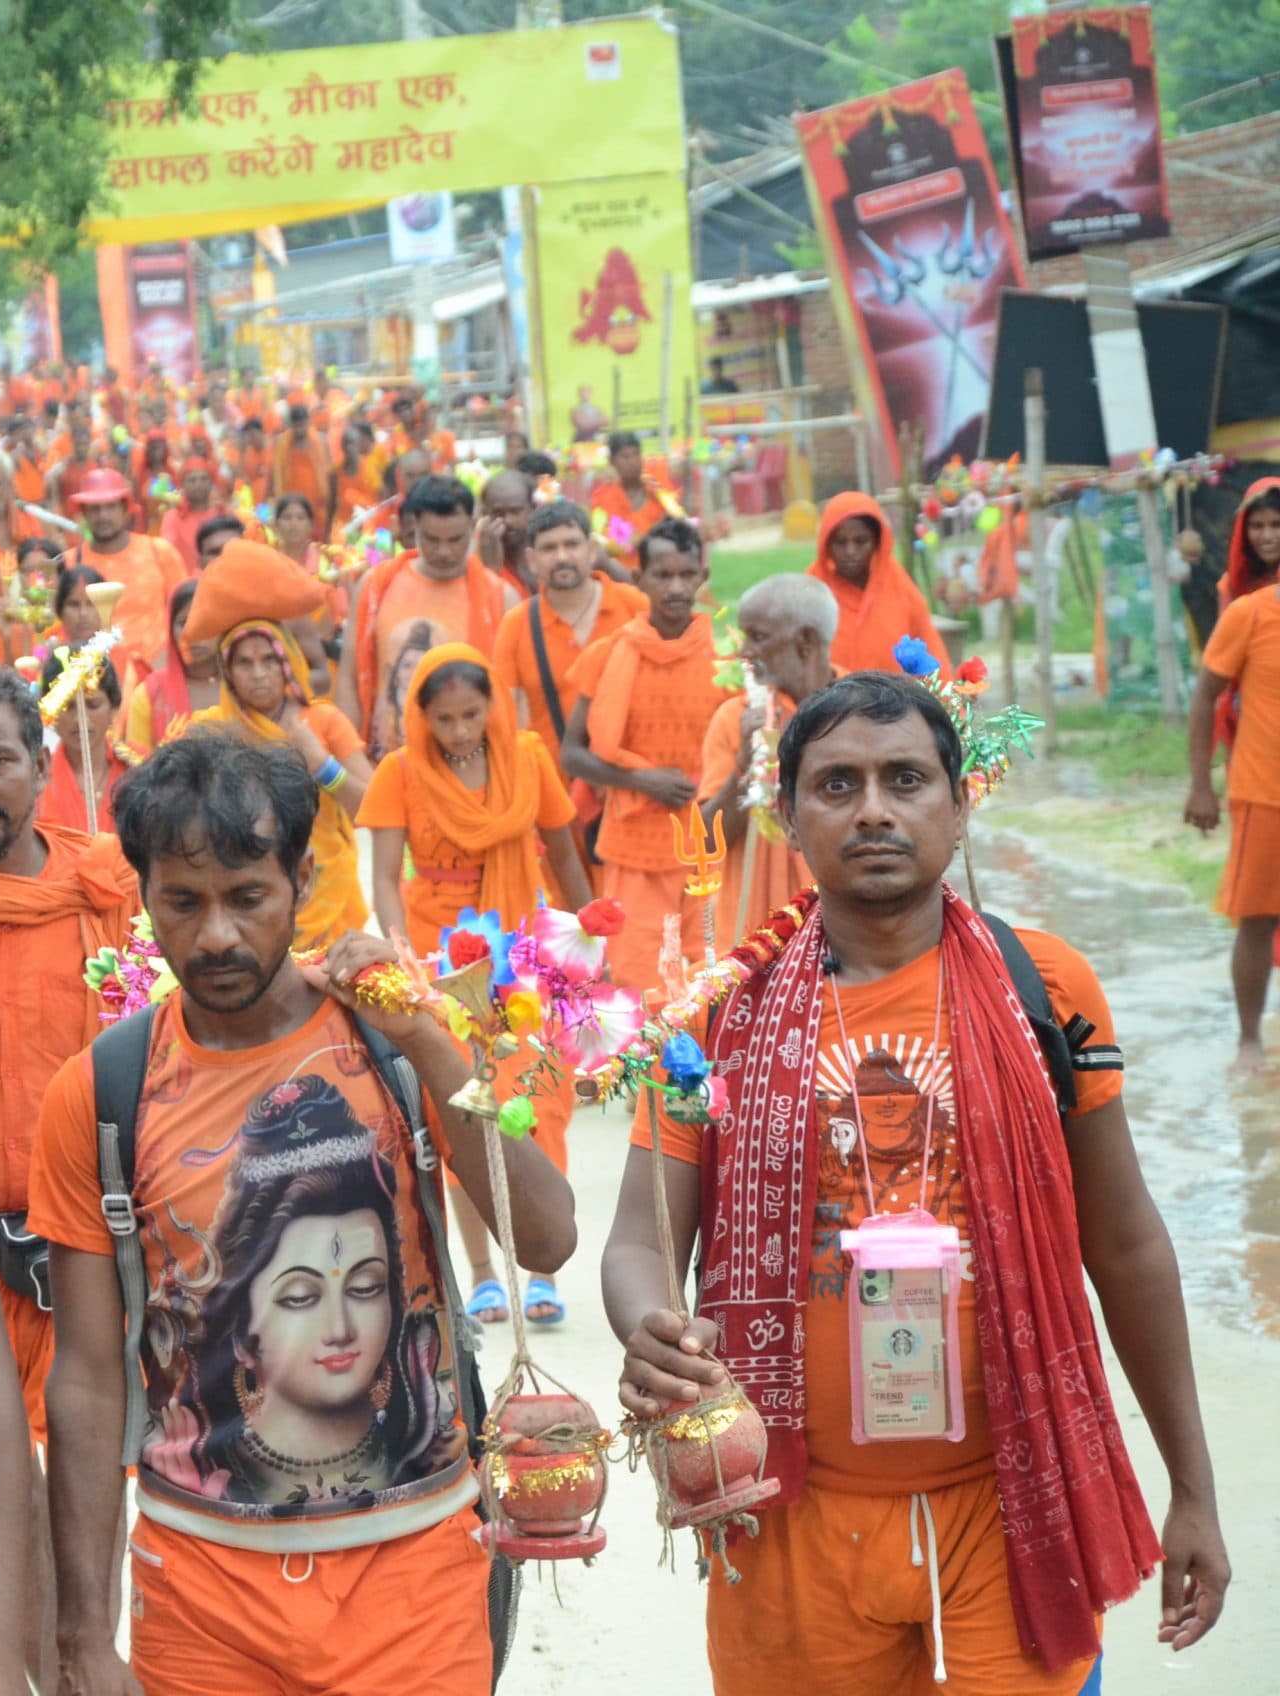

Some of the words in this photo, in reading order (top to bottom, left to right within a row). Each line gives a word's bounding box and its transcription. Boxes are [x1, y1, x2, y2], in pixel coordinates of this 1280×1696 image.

[103, 96, 179, 129] ात्रा
[284, 71, 382, 116] मौका
[396, 72, 466, 109] एक,
[108, 153, 210, 190] सफल
[223, 132, 318, 178] करेंगे
[333, 123, 457, 173] महादेव
[764, 1089, 794, 1172] महाकाल
[763, 1180, 786, 1220] जय
[745, 1309, 786, 1351] ॐ
[761, 1388, 793, 1409] जय
